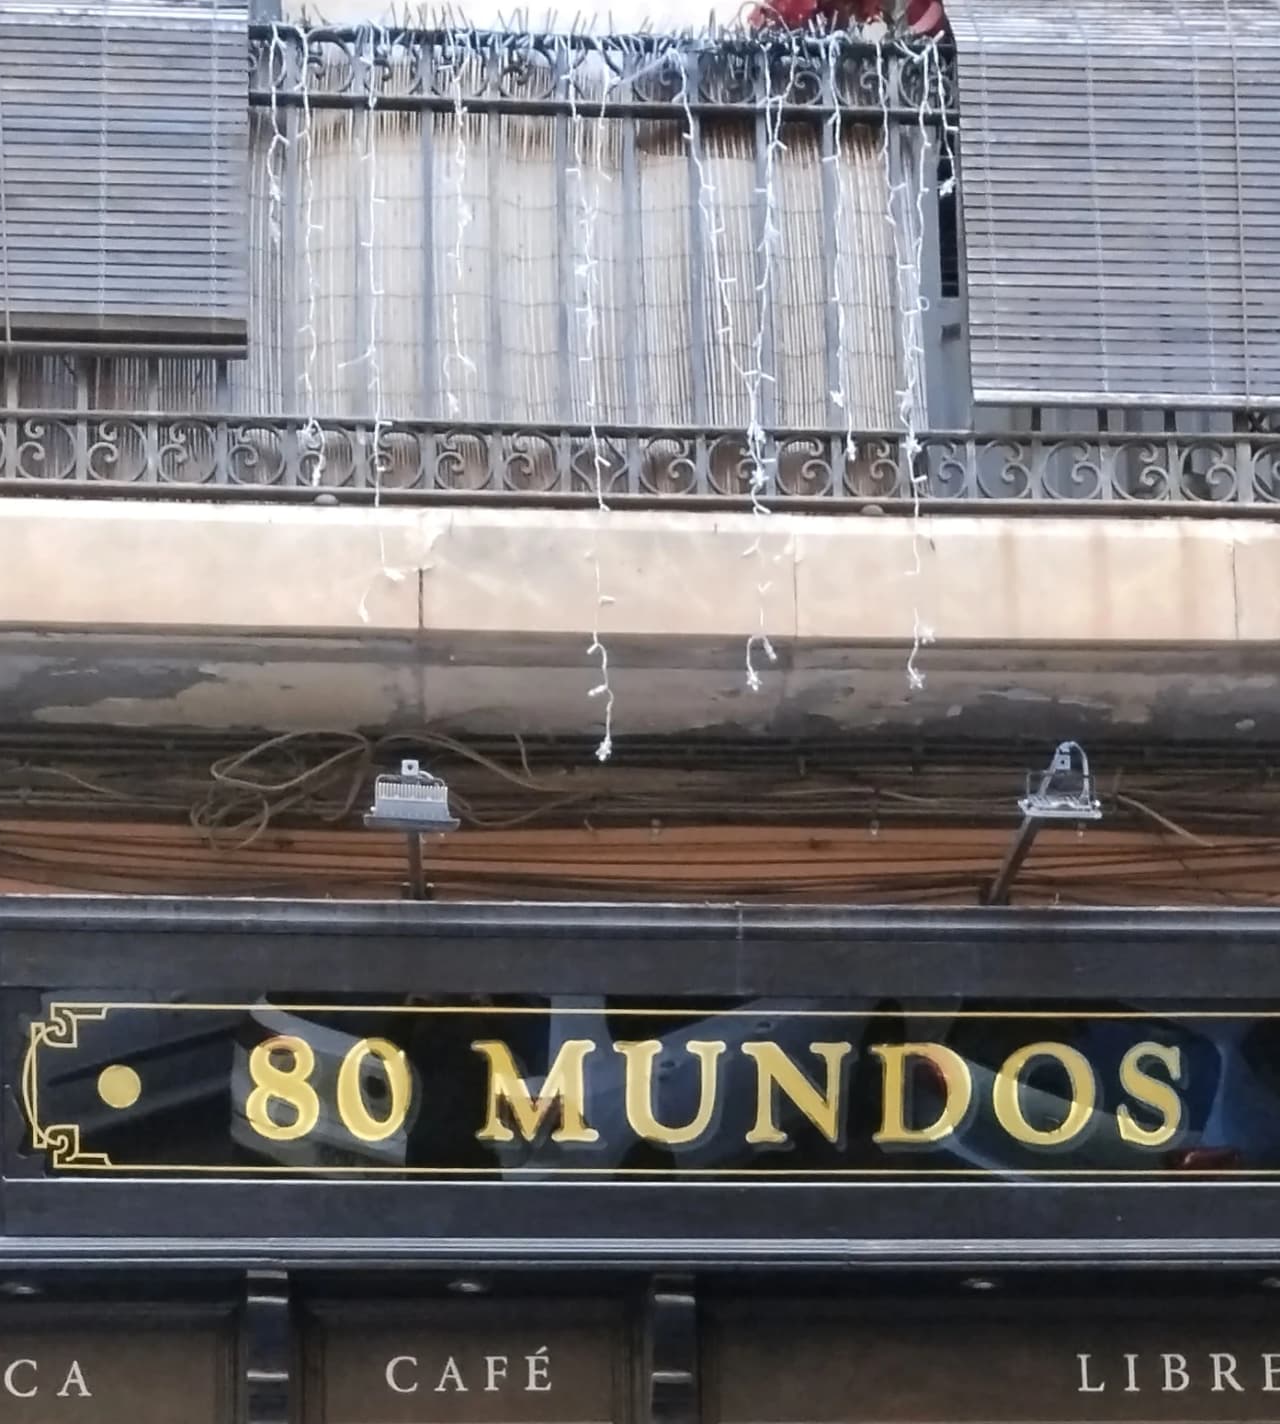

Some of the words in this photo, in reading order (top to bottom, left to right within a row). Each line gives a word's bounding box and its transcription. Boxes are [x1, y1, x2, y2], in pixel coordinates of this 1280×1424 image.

[245, 1034, 413, 1142] 80
[470, 1039, 1182, 1146] MUNDOS
[384, 1345, 553, 1394] CAFÉ
